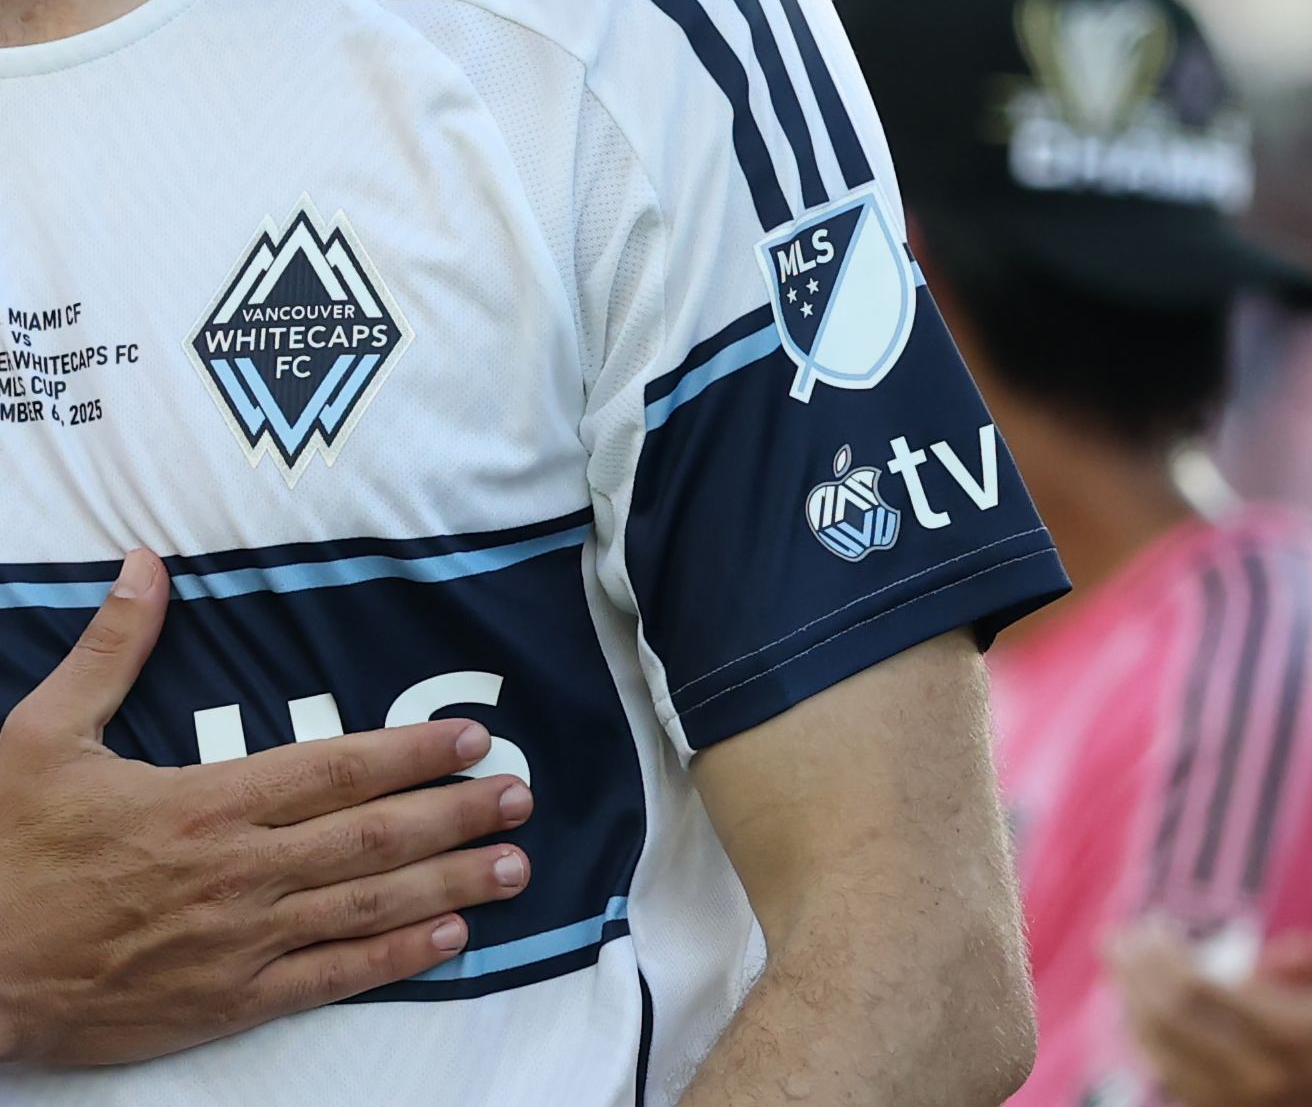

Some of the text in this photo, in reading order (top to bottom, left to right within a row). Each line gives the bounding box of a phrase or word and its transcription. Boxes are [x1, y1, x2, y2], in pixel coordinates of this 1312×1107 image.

[777, 229, 834, 283] MLS
[8, 307, 62, 331] MIAMI
[66, 303, 82, 325] CF
[242, 304, 355, 322] VANCOUVER
[205, 325, 388, 353] WHITECAPS
[12, 346, 108, 376] WHITECAPS
[115, 344, 139, 365] FC
[276, 356, 312, 379] FC
[31, 376, 67, 399] CUP
[51, 404, 65, 426] 6,
[69, 399, 103, 426] 2025
[887, 424, 1000, 529] tv
